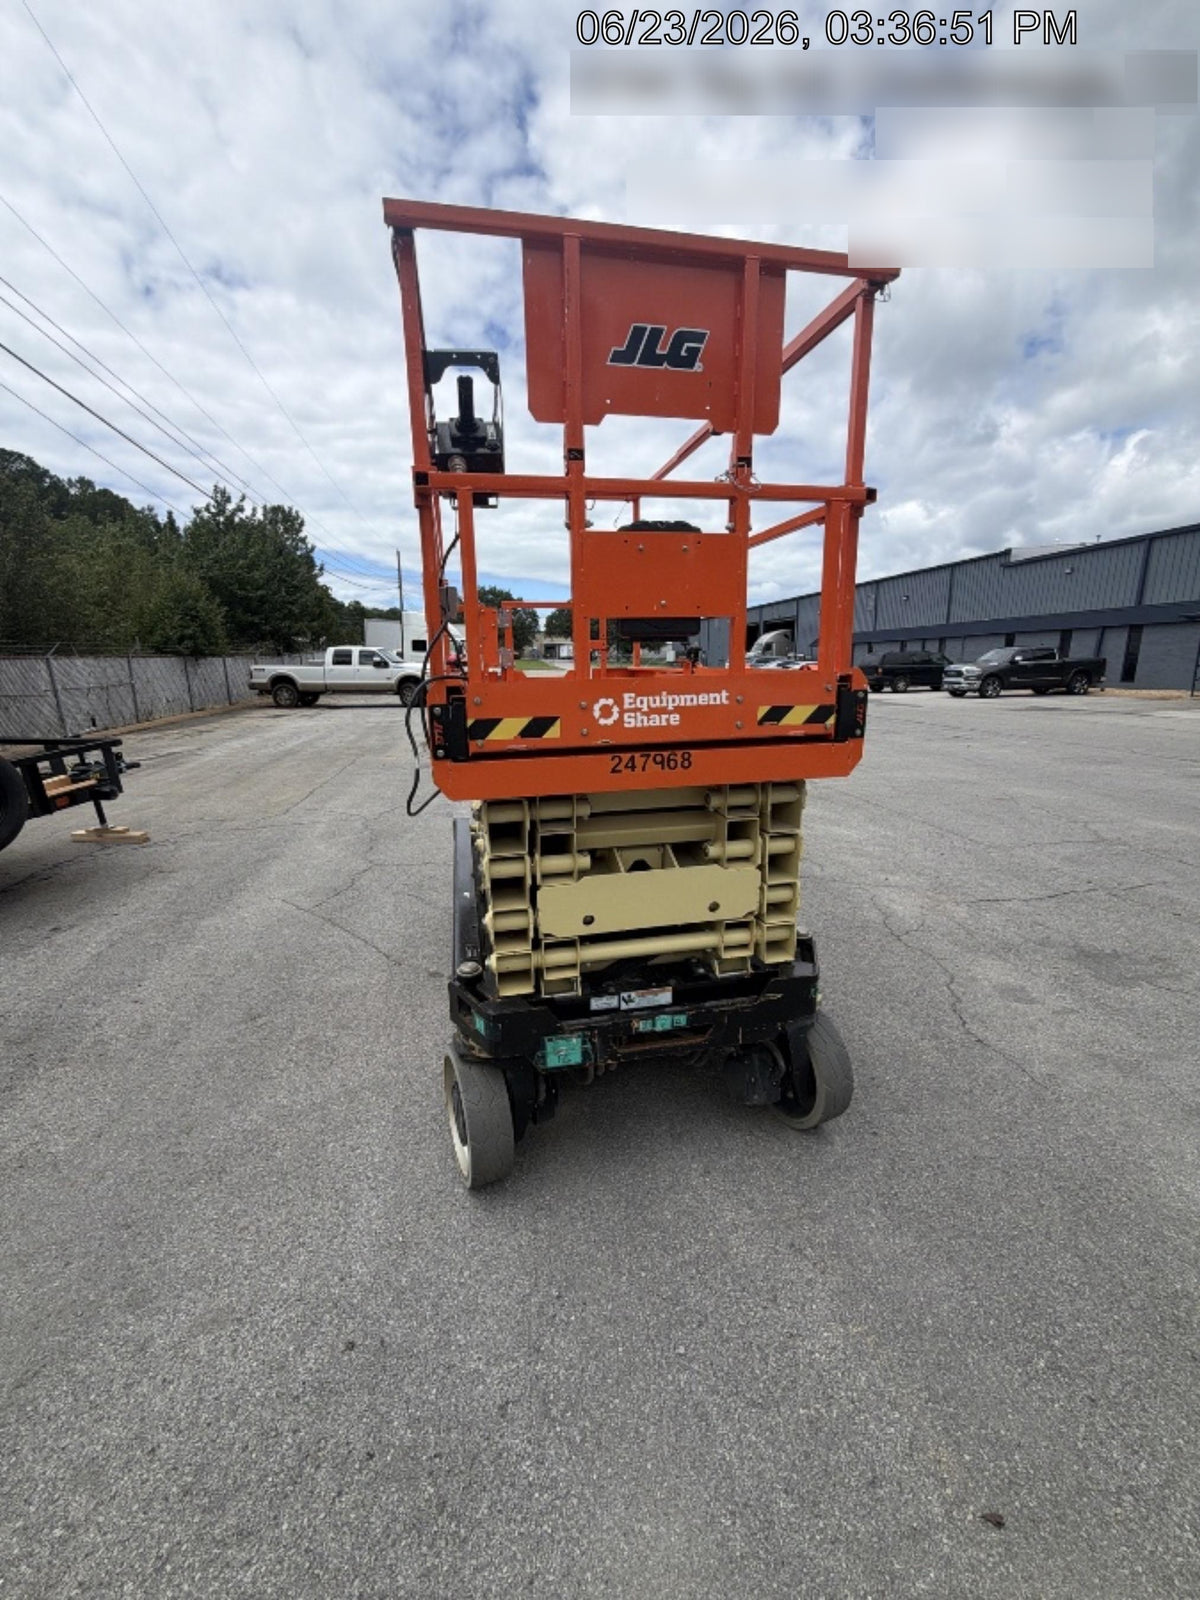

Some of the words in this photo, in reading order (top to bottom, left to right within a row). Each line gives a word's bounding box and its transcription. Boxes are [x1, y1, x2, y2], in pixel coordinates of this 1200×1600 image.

[606, 323, 710, 372] JLG
[622, 689, 730, 711] Equipment
[623, 712, 681, 728] Share
[609, 751, 692, 774] 247968
